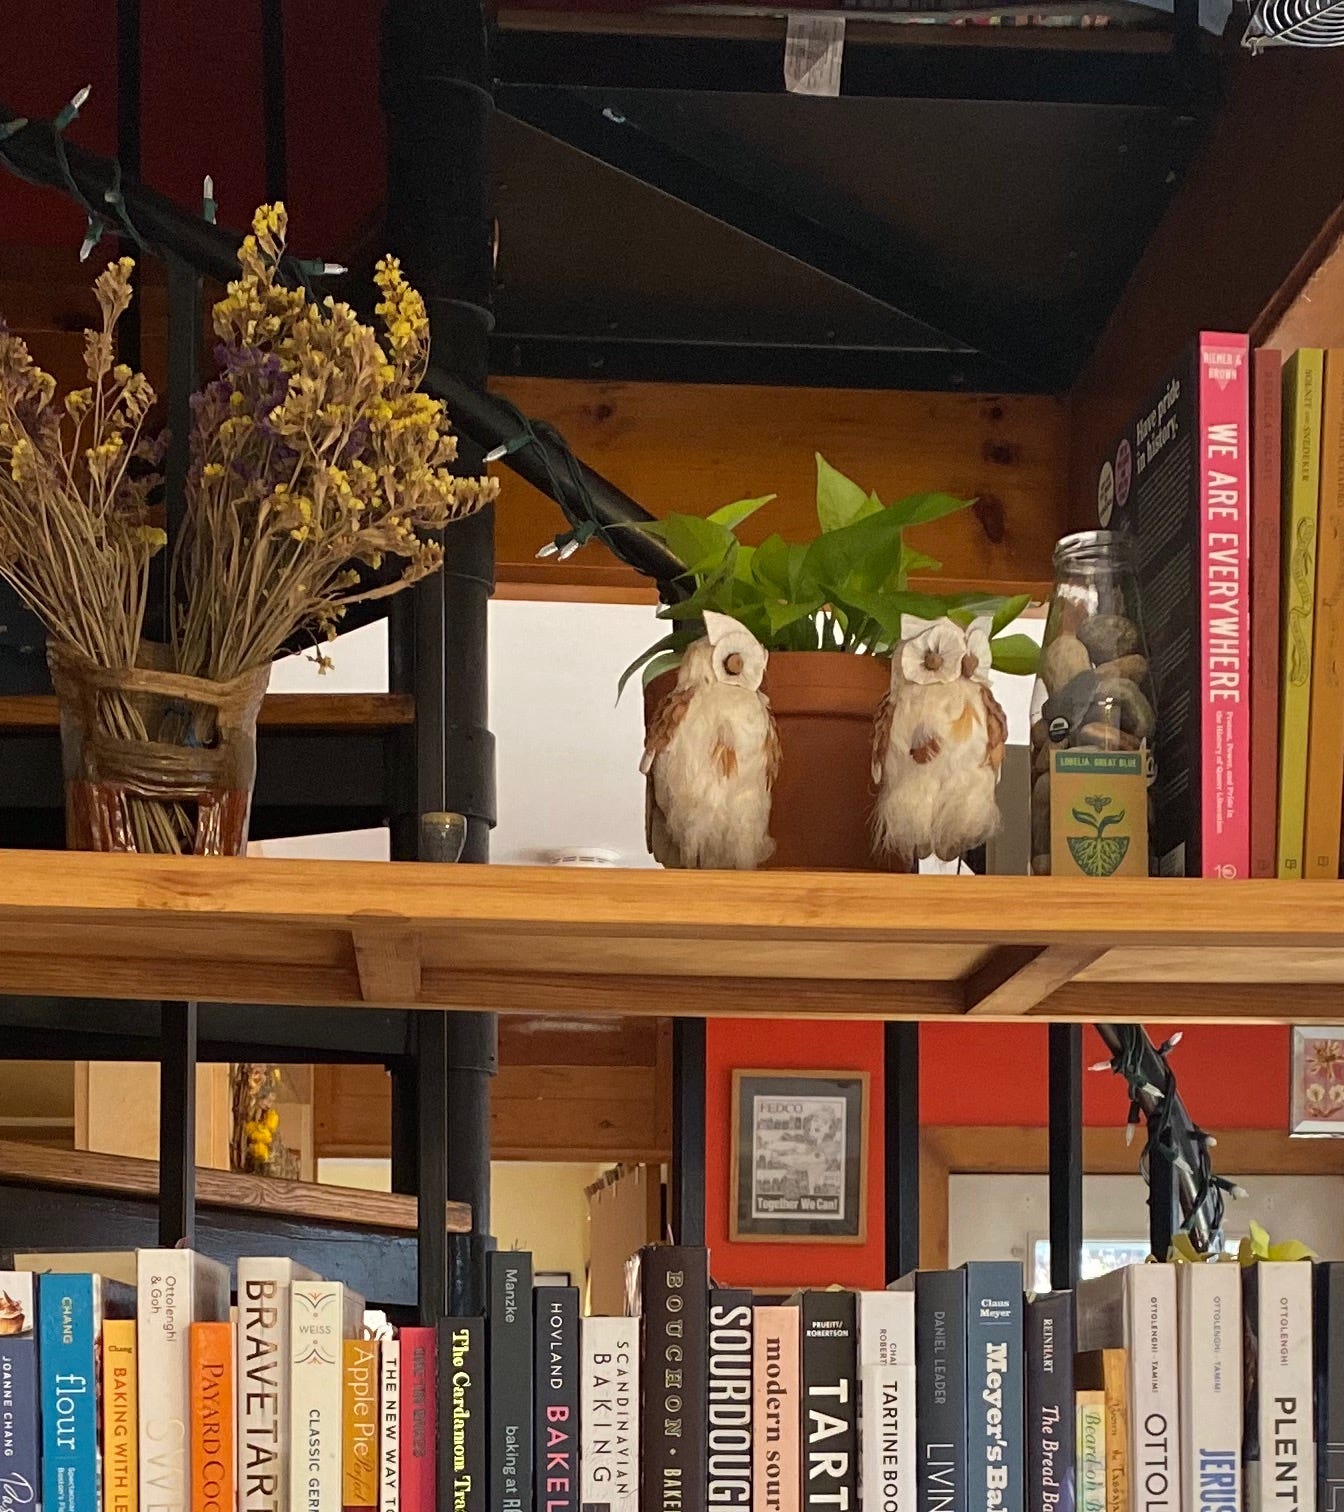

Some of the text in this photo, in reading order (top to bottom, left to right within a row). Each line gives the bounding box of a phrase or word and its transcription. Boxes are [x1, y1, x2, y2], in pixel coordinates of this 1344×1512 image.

[1136, 378, 1181, 447] Have pride
[1137, 451, 1147, 475] in
[1207, 423, 1240, 703] WE ARE EVERYWHERE
[759, 1103, 803, 1113] FEDCO
[757, 1197, 799, 1212] Together
[801, 1197, 816, 1210] We
[61, 1297, 74, 1345] CHANG
[504, 1268, 518, 1324] Manzke
[549, 1302, 563, 1390] HOVLAND
[1042, 1318, 1053, 1373] REINHART
[55, 1373, 87, 1451] flour
[113, 1367, 129, 1437] BAKING
[764, 1337, 788, 1443] modern
[982, 1343, 1008, 1461] Meyer's
[114, 1442, 128, 1484] WITH
[308, 1409, 321, 1472] CLASSIC
